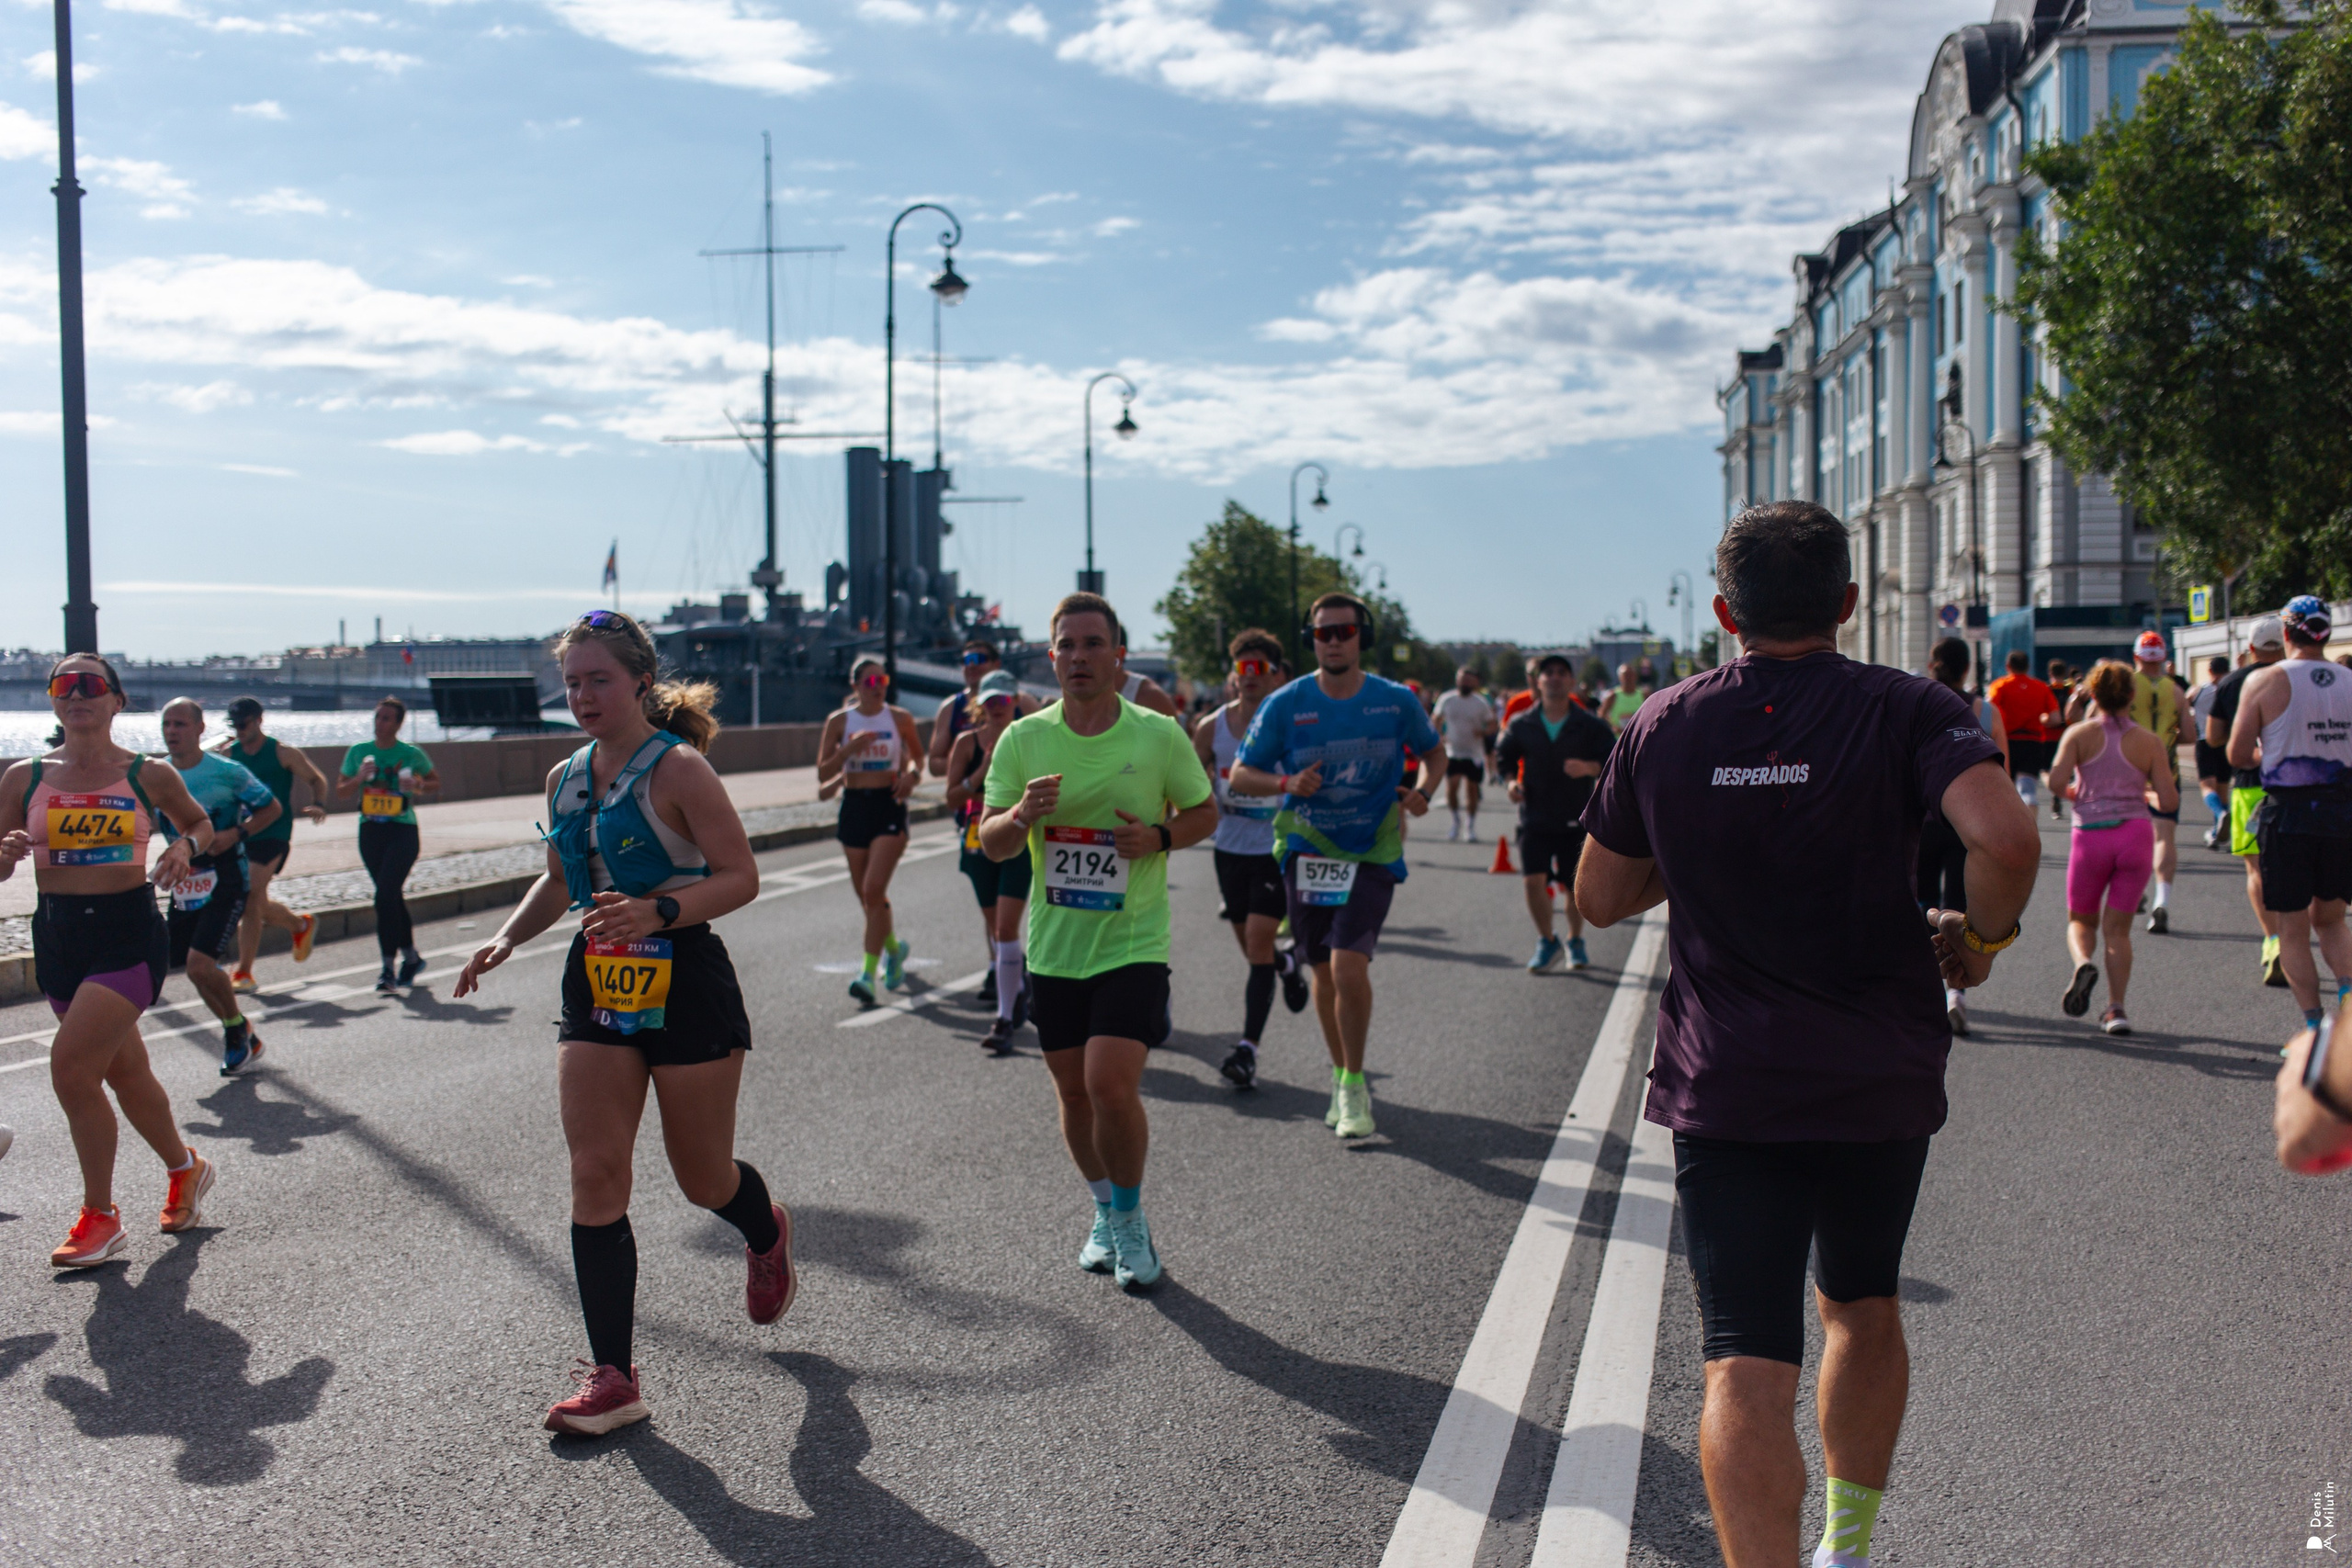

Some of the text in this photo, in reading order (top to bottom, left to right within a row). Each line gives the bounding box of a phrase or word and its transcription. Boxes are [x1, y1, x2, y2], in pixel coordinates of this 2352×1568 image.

[1711, 764, 1810, 785] DESPERADOS
[59, 815, 123, 837] 4474
[58, 851, 67, 863] E
[1055, 849, 1117, 878] 2194
[1306, 862, 1349, 881] 5756
[1065, 875, 1104, 886] ДМИТРИЙ
[1052, 889, 1061, 903] E
[628, 943, 642, 953] 21,1
[594, 964, 657, 995] 1407
[600, 1010, 610, 1025] D
